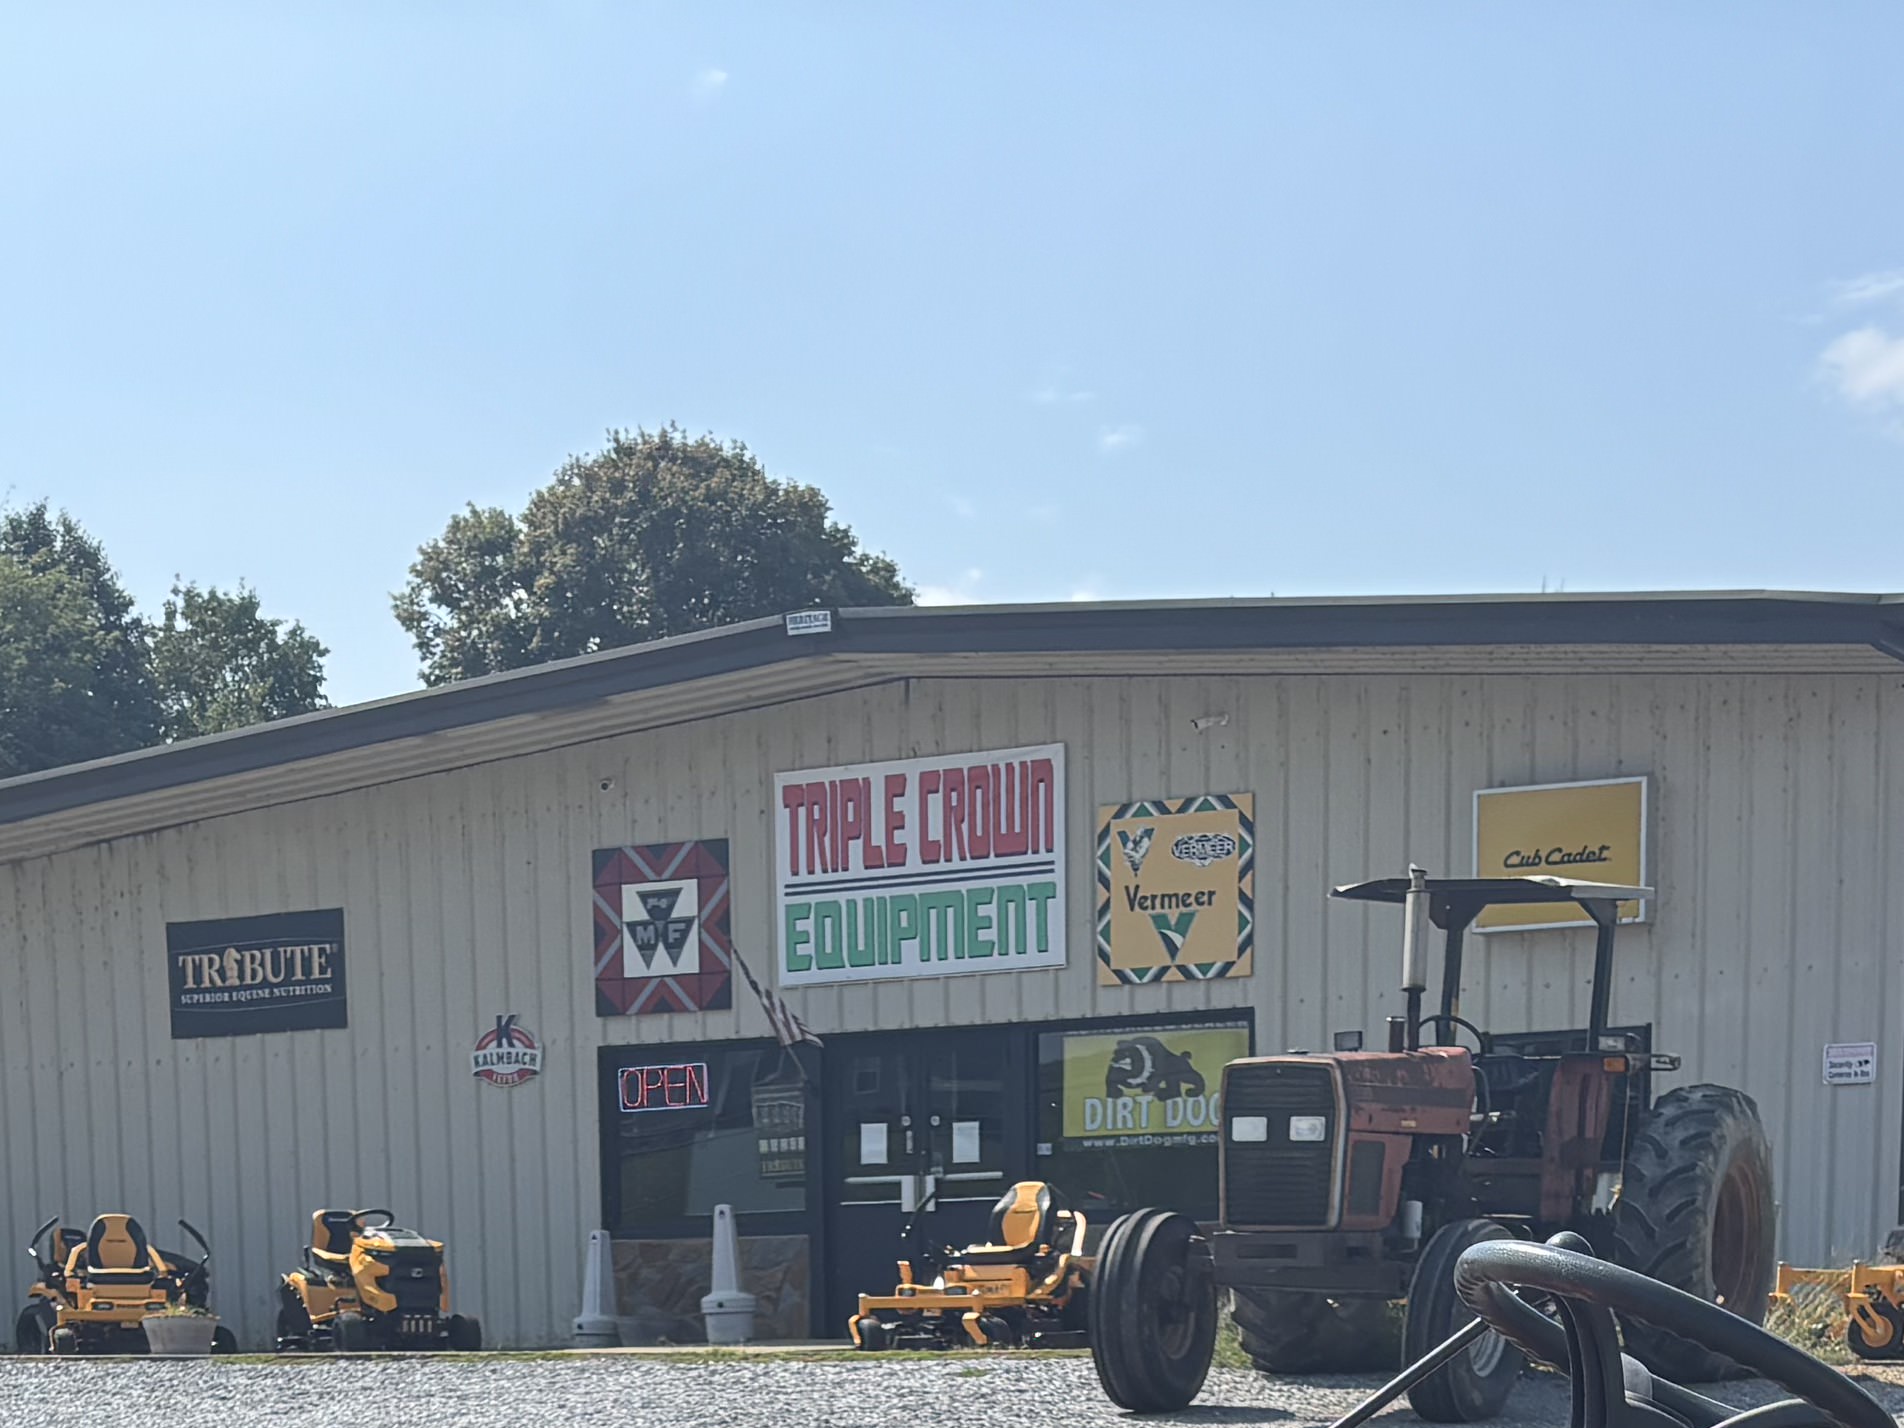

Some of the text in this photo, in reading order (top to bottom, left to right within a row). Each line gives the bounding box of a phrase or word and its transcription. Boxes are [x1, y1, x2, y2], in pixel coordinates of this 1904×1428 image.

[782, 758, 1054, 876] TRIPLE CROWN
[1504, 845, 1611, 868] Cub Cadet
[1124, 884, 1217, 912] Vermeer
[784, 881, 1057, 972] EQUIPMENT
[181, 992, 230, 1005] SUPERIOR
[273, 983, 333, 997] NUTRITION
[623, 1066, 708, 1107] OPEN
[1084, 1095, 1153, 1131] DIRT
[1082, 1134, 1218, 1148] www.DirtDogmfg.co
